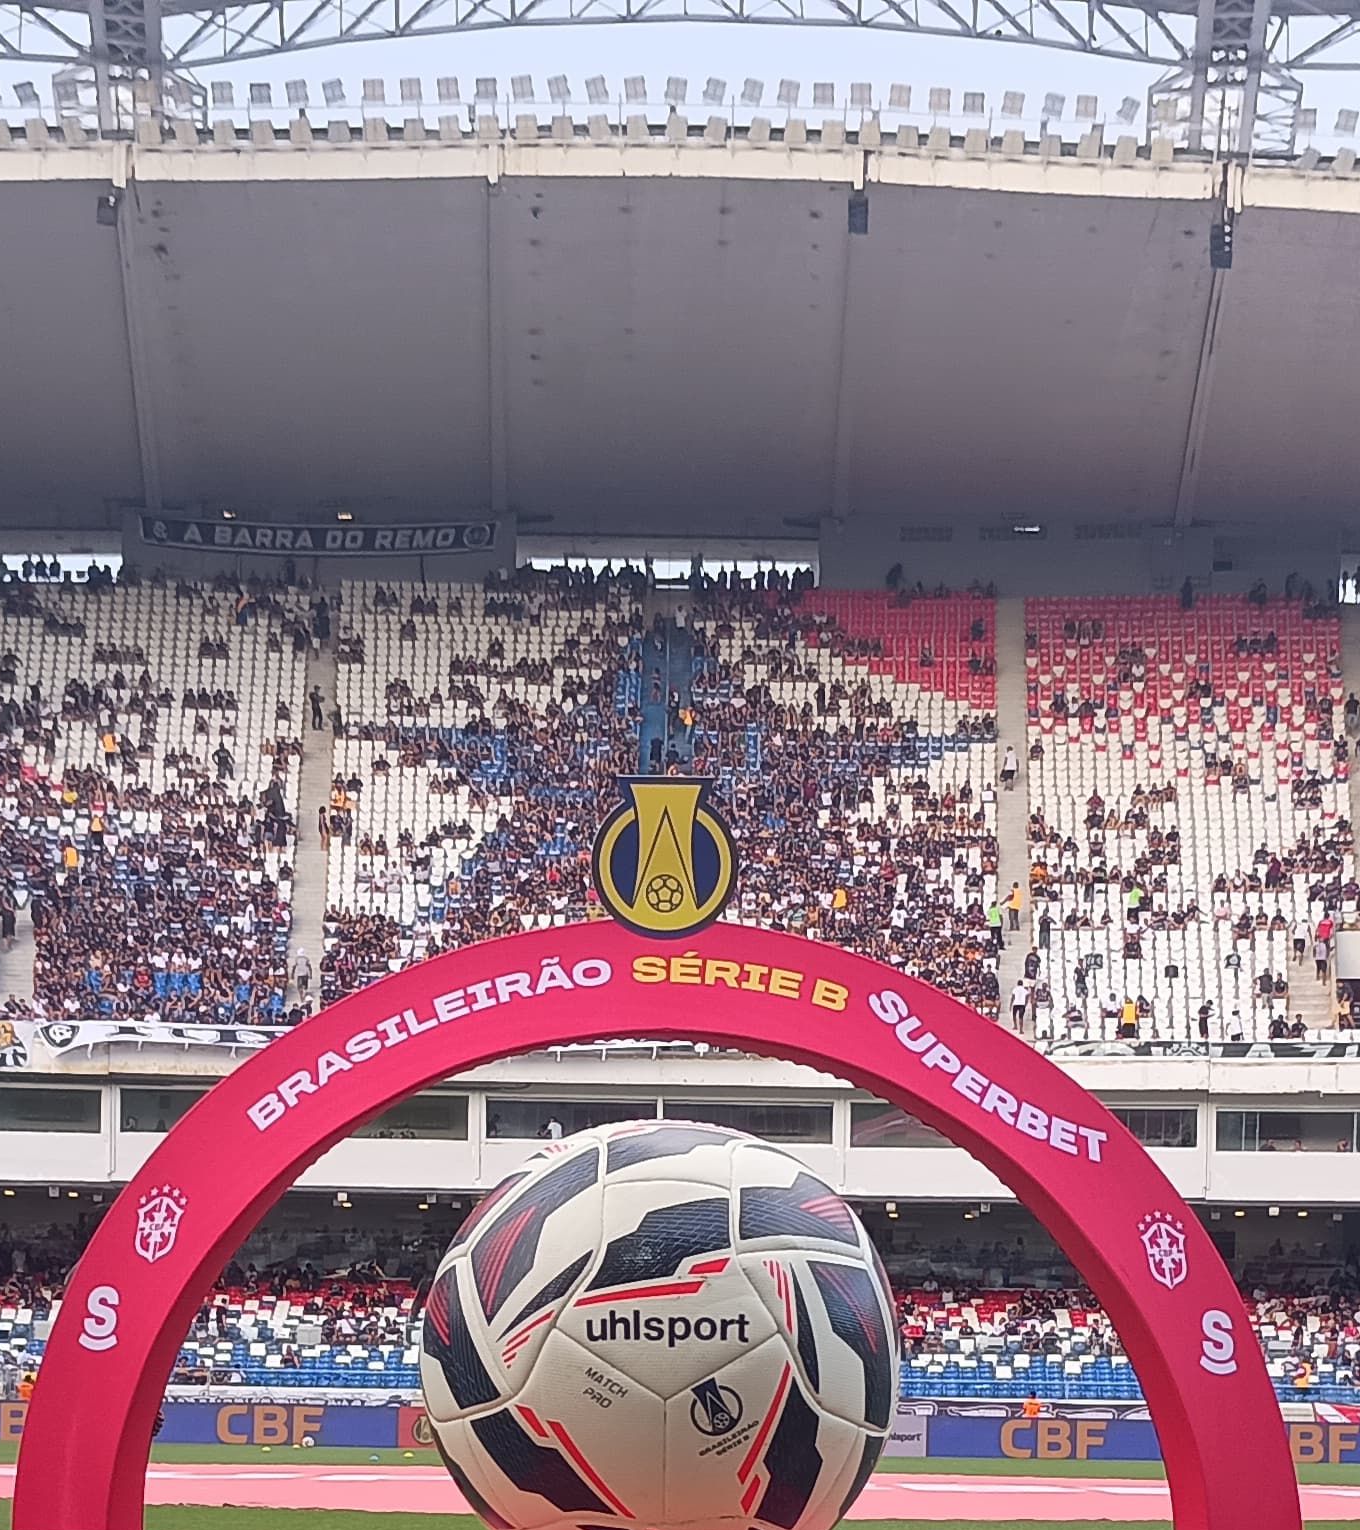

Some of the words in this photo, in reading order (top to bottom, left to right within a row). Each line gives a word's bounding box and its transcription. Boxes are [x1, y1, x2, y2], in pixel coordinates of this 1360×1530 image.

[183, 527, 203, 544] A
[214, 525, 314, 549] BARRA
[325, 529, 365, 550] DO
[374, 526, 458, 550] REMO
[247, 955, 612, 1131] BRASILEIRÃO
[632, 952, 803, 998] SÉRIE
[812, 978, 850, 1011] B
[867, 989, 1109, 1163] SUPERBET
[586, 1309, 750, 1348] uhlsport
[582, 1387, 613, 1409] PRO
[585, 1367, 629, 1399] MATCH
[216, 1404, 325, 1445] CBF
[1000, 1419, 1108, 1460] CBF
[1288, 1423, 1360, 1464] BF
